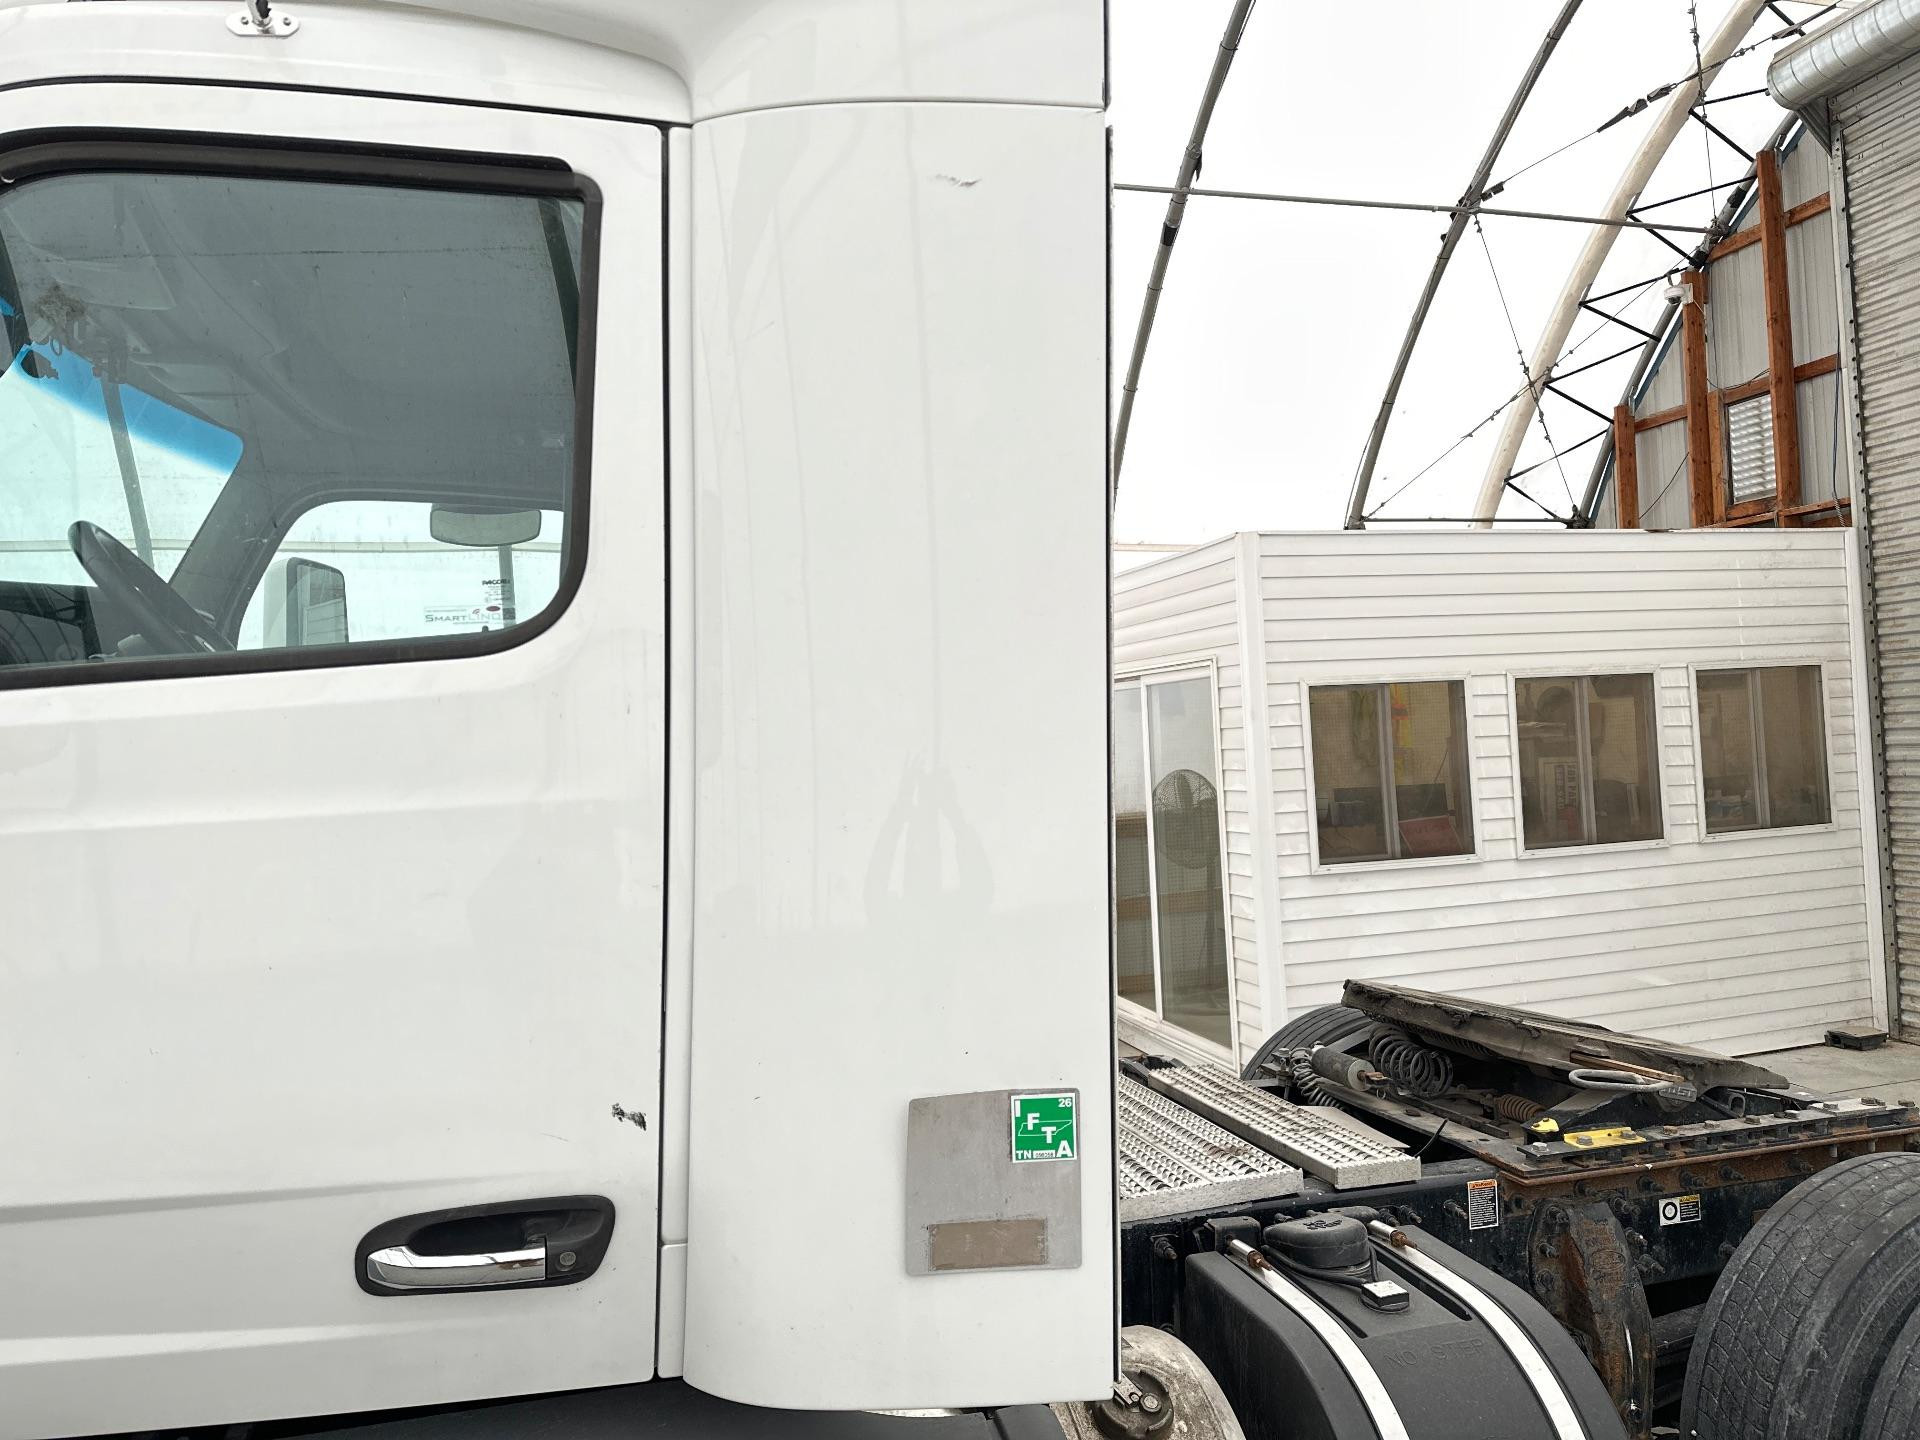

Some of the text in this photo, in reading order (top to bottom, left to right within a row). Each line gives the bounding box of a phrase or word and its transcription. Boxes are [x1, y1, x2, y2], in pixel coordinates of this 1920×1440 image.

[1058, 1098, 1072, 1108] 26
[1016, 1149, 1032, 1159] TN
[1384, 1350, 1418, 1368] NO
